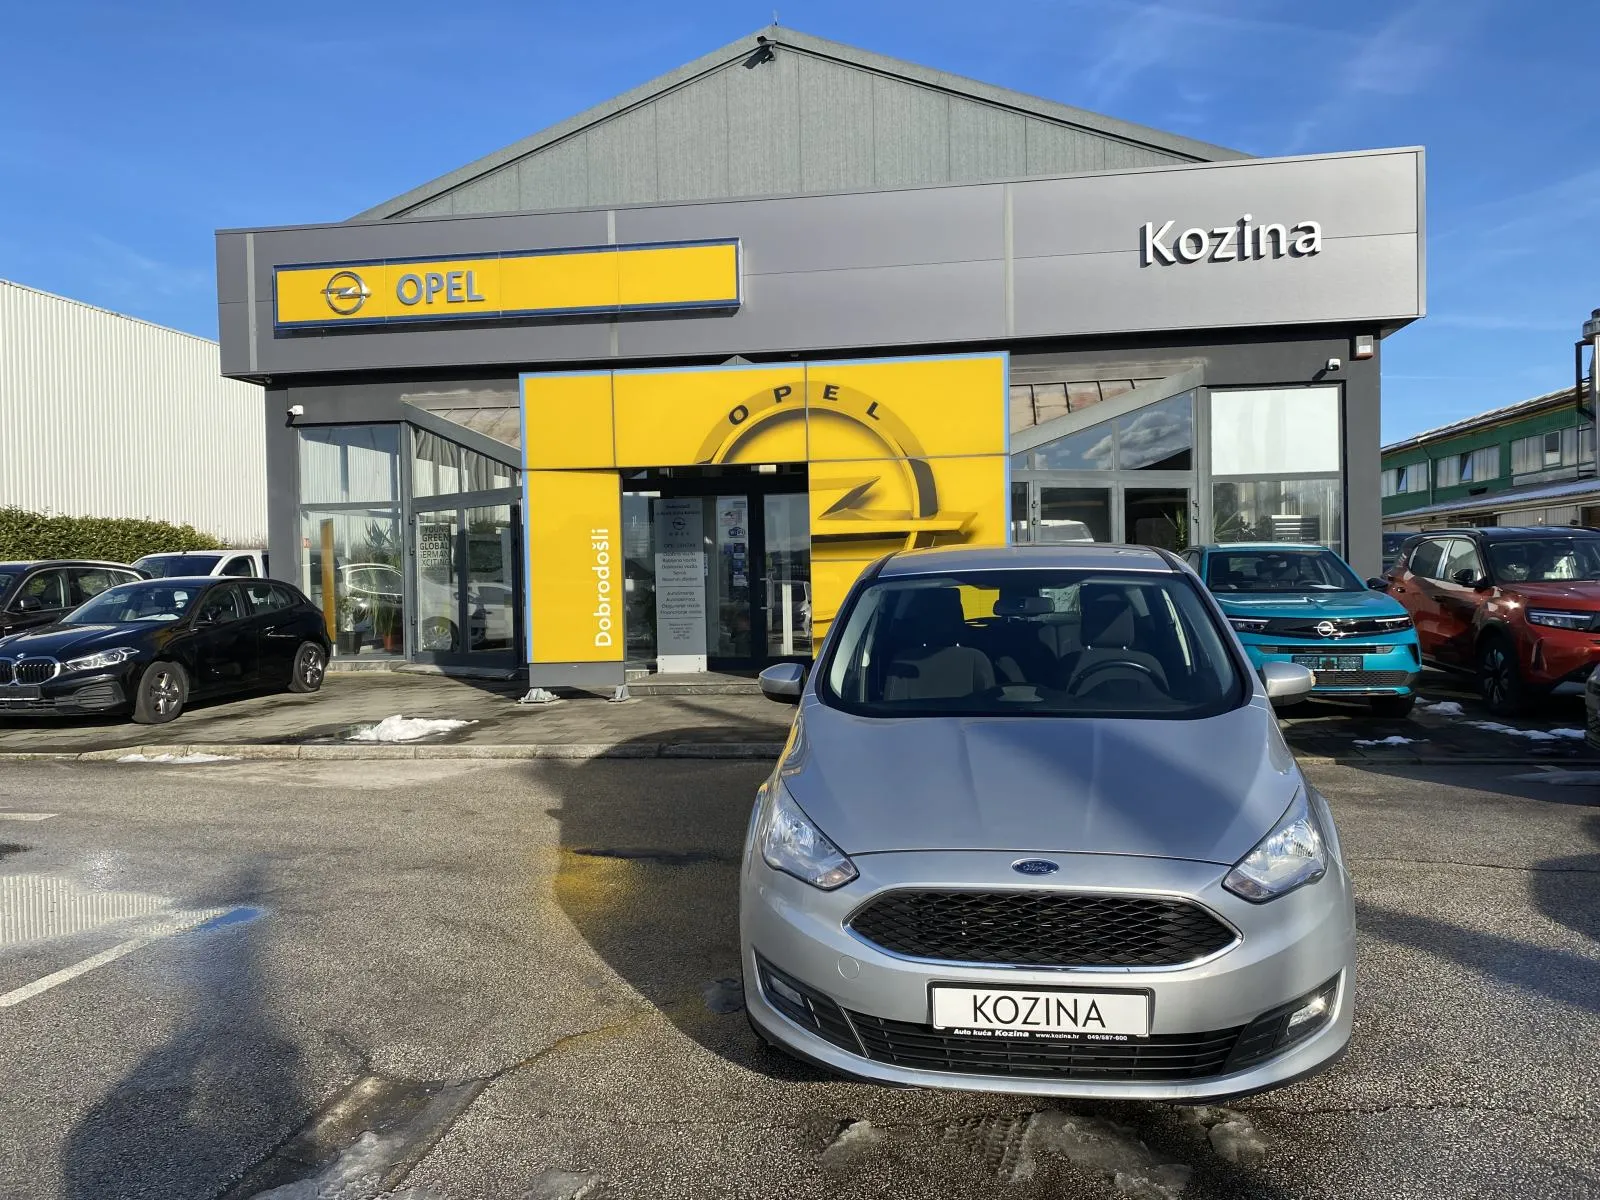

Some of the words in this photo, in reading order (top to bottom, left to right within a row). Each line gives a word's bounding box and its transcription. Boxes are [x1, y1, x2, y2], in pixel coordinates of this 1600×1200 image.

[1139, 213, 1322, 268] Kozina
[396, 270, 485, 306] OPEL
[728, 384, 880, 425] OPEL
[419, 542, 449, 551] GLOBAL
[422, 533, 449, 542] GREEN
[591, 528, 612, 647] Dobrodošli
[973, 994, 1106, 1029] KOZINA
[954, 1028, 971, 1036] Auto
[973, 1029, 992, 1037] kuća
[995, 1029, 1030, 1038] Kozina
